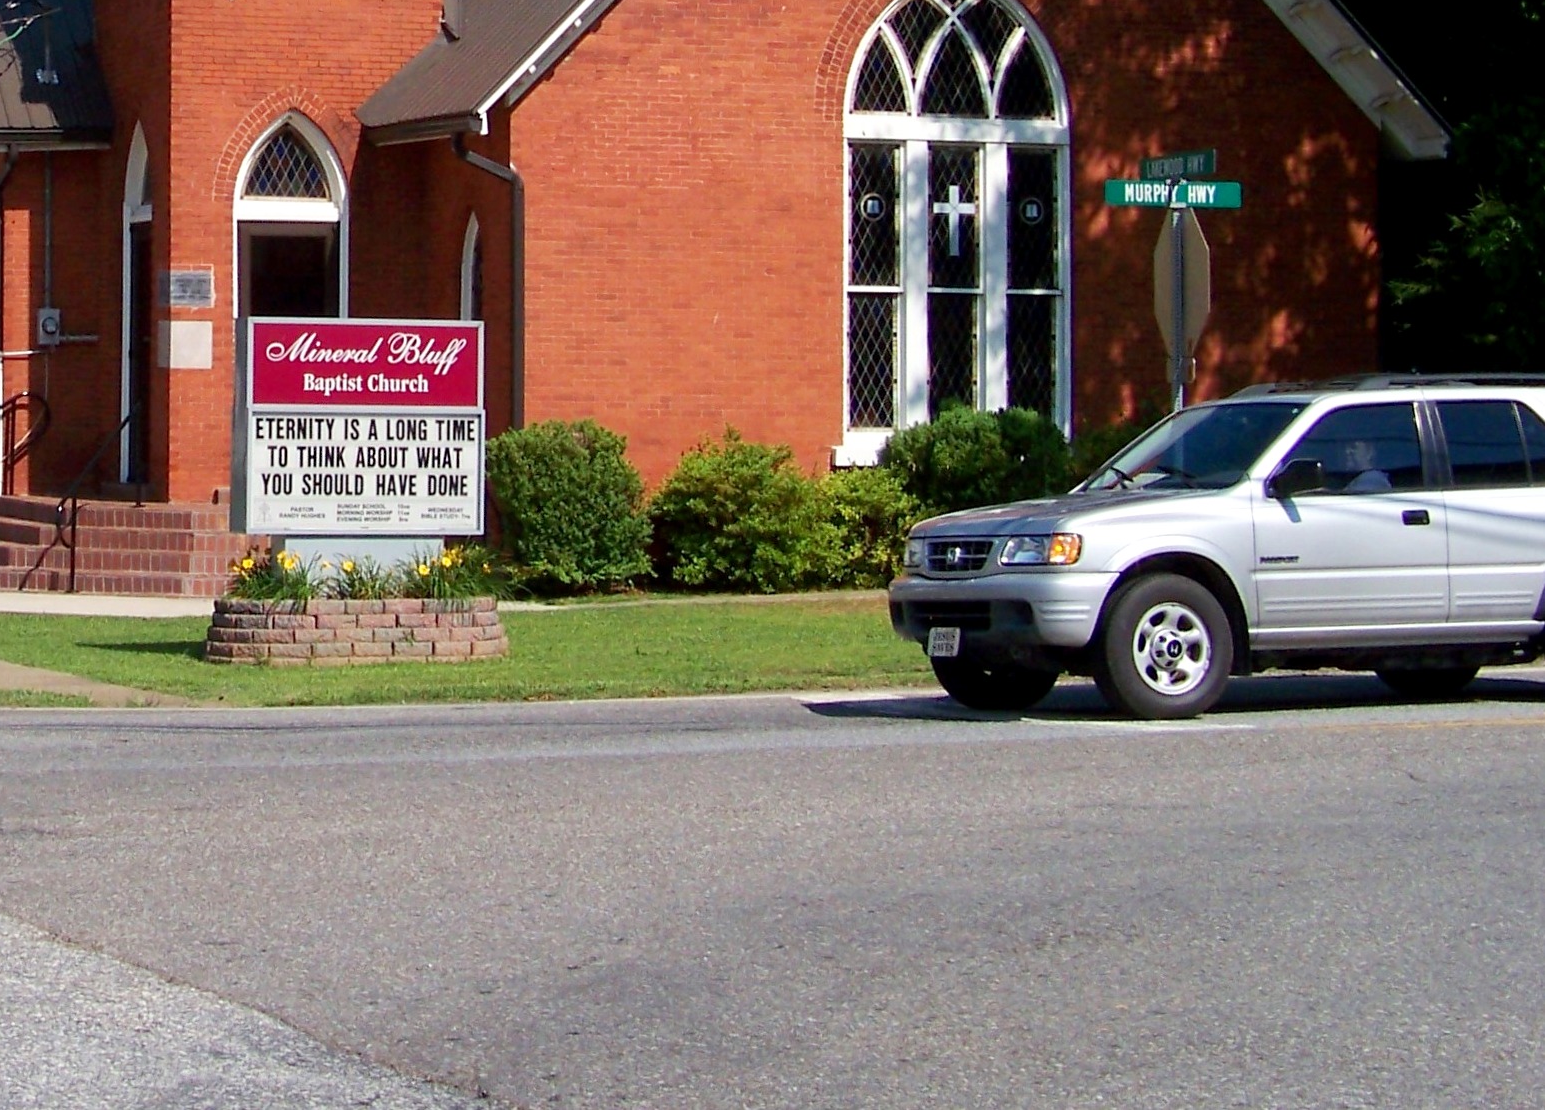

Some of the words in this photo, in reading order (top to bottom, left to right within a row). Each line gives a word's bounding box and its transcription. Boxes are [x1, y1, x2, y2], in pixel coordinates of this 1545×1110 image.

[1124, 183, 1178, 203] MURPHY
[1187, 185, 1216, 204] HWY
[265, 332, 384, 364] Mineral
[387, 332, 467, 376] Bluff
[303, 373, 363, 396] Baptist
[367, 373, 429, 393] Church
[256, 418, 335, 440] ETERNITY
[344, 418, 360, 441] IS
[367, 418, 379, 441] A
[386, 419, 428, 441] LONG
[435, 419, 475, 442] TIME
[267, 445, 288, 468] TO
[297, 445, 346, 468] THINK
[355, 446, 408, 469] ABOUT
[416, 446, 463, 469] WHAT
[261, 473, 293, 496] YOU
[301, 473, 364, 496] SHOULD
[376, 474, 417, 496] HAVE
[428, 474, 468, 497] DONE
